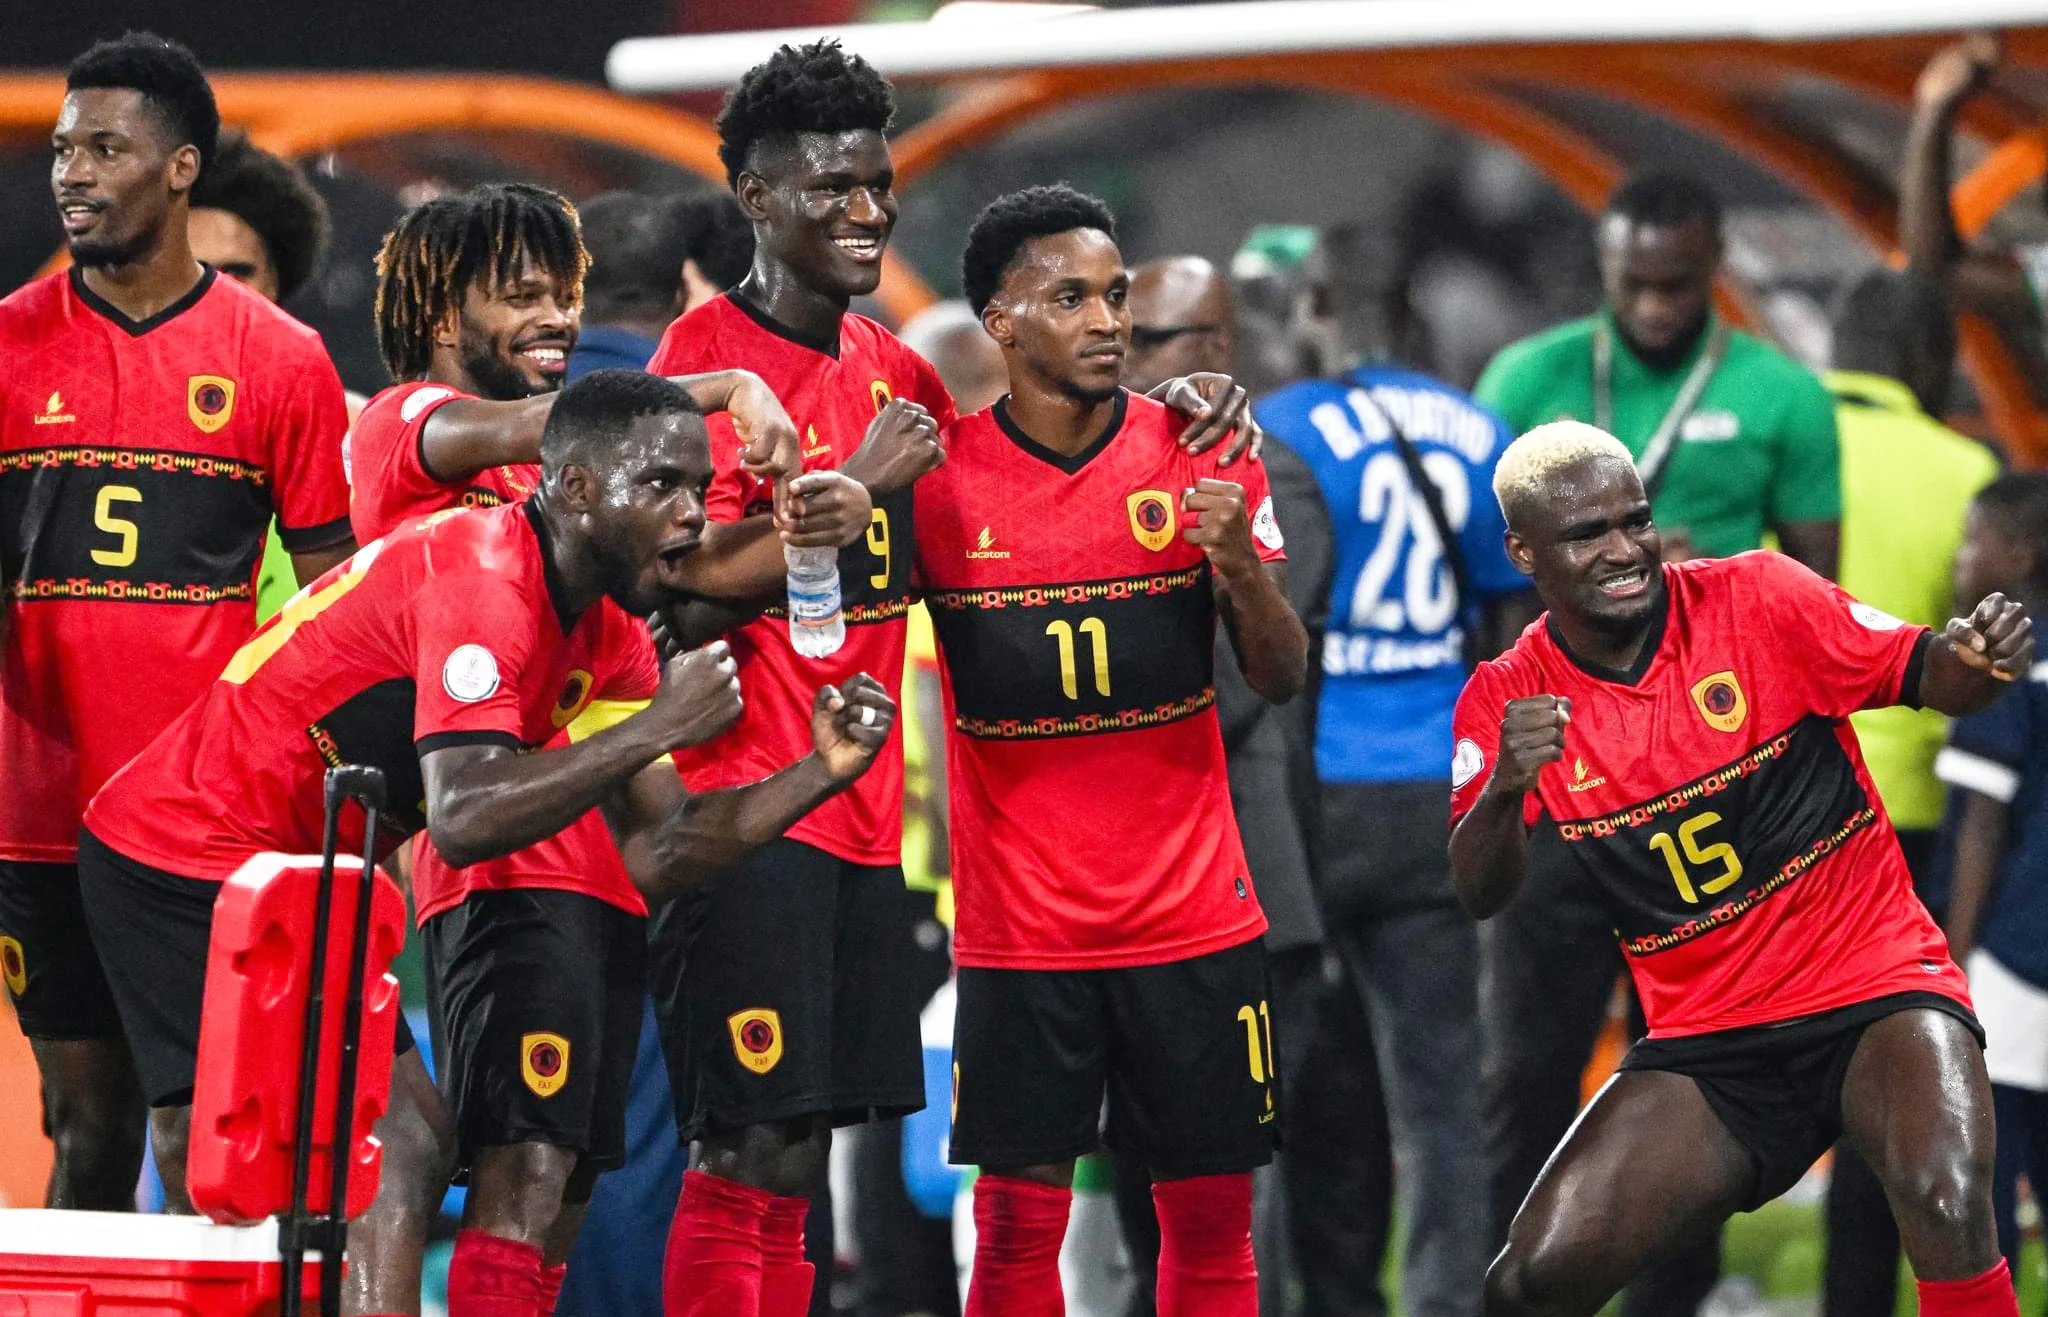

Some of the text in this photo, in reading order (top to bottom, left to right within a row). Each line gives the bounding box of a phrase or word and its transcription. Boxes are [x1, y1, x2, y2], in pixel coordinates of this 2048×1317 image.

[90, 485, 143, 567] 5
[965, 549, 1010, 559] Lacatoni
[1045, 616, 1111, 700] 11
[1567, 776, 1606, 792] Lacatoni
[1649, 811, 1743, 904] 15
[1237, 1000, 1274, 1083] 11
